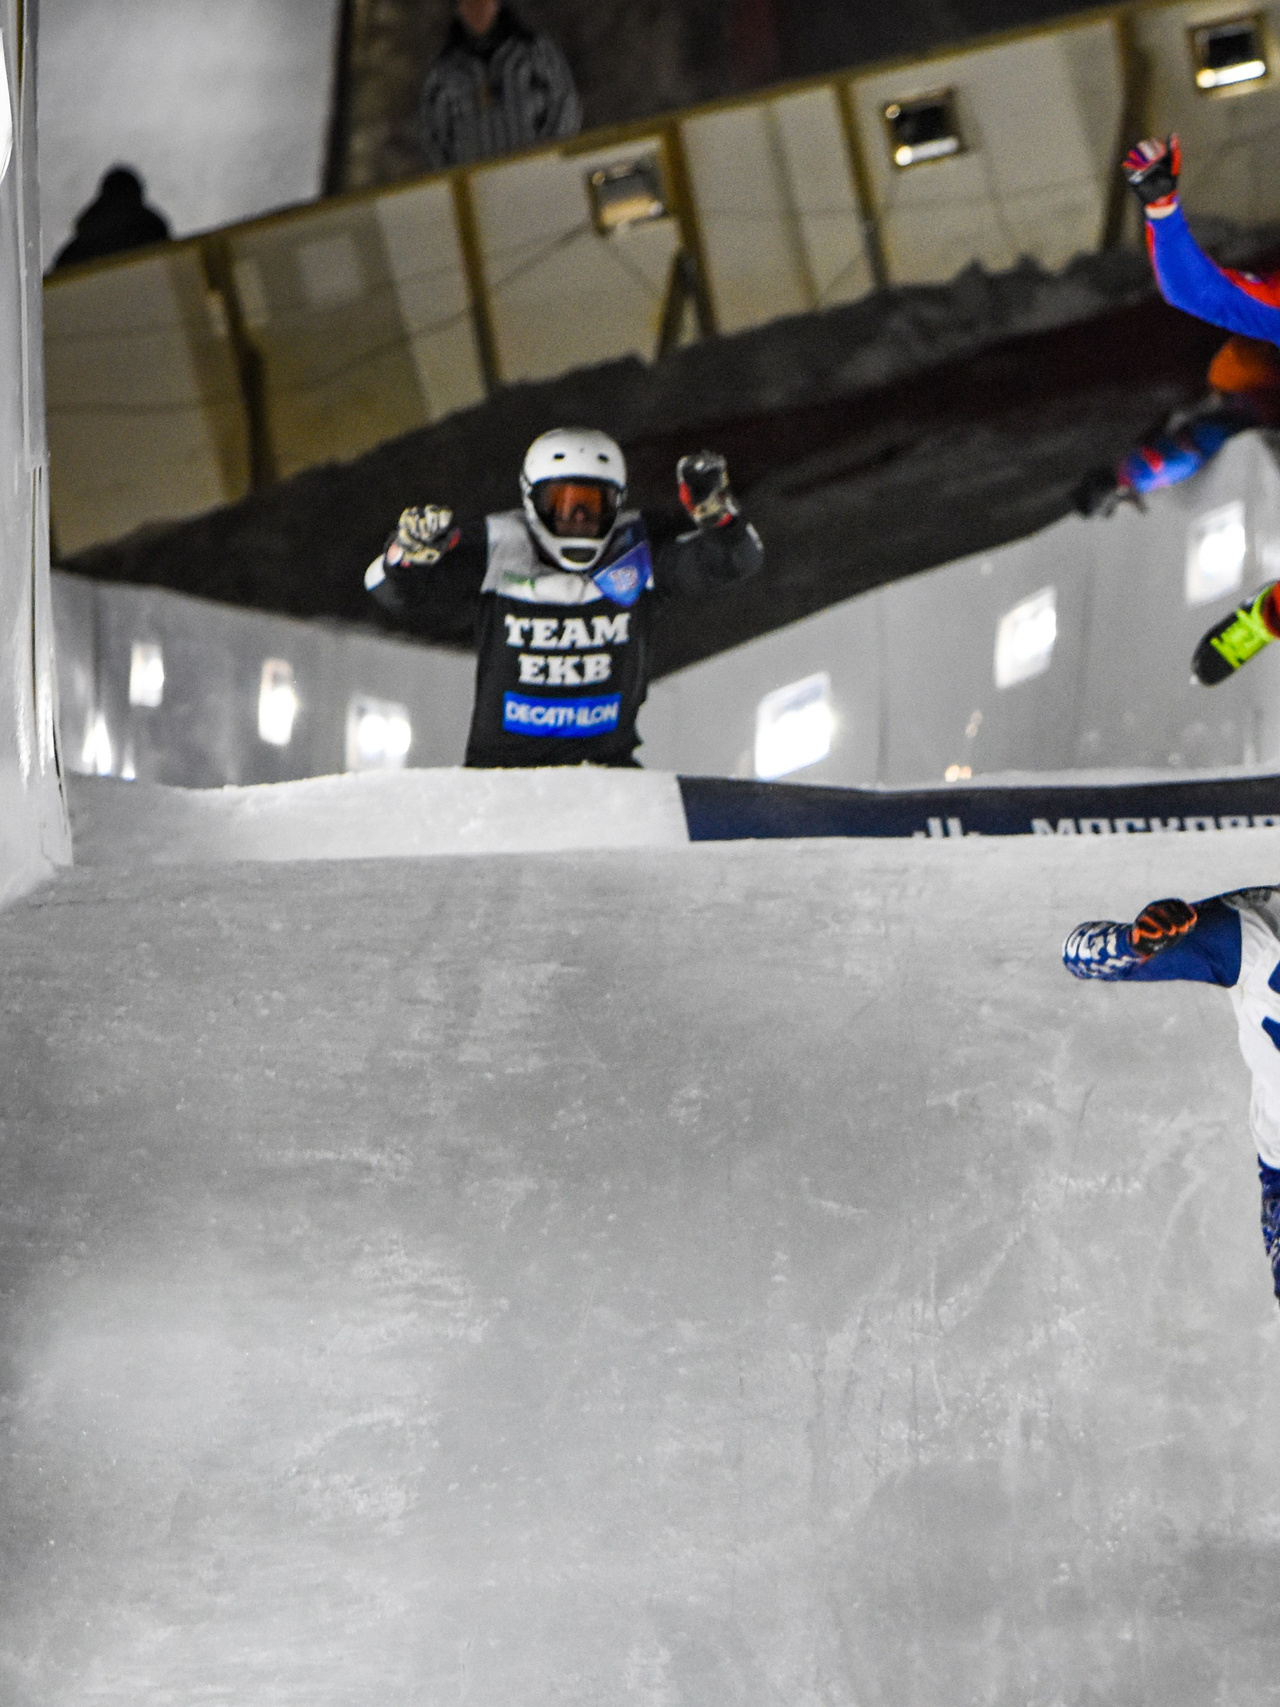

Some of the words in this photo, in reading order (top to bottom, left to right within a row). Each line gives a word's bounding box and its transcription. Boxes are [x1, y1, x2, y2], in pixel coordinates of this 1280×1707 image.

[505, 613, 630, 648] TEAM
[519, 653, 612, 685] EKB
[505, 700, 619, 728] DECATHLON
